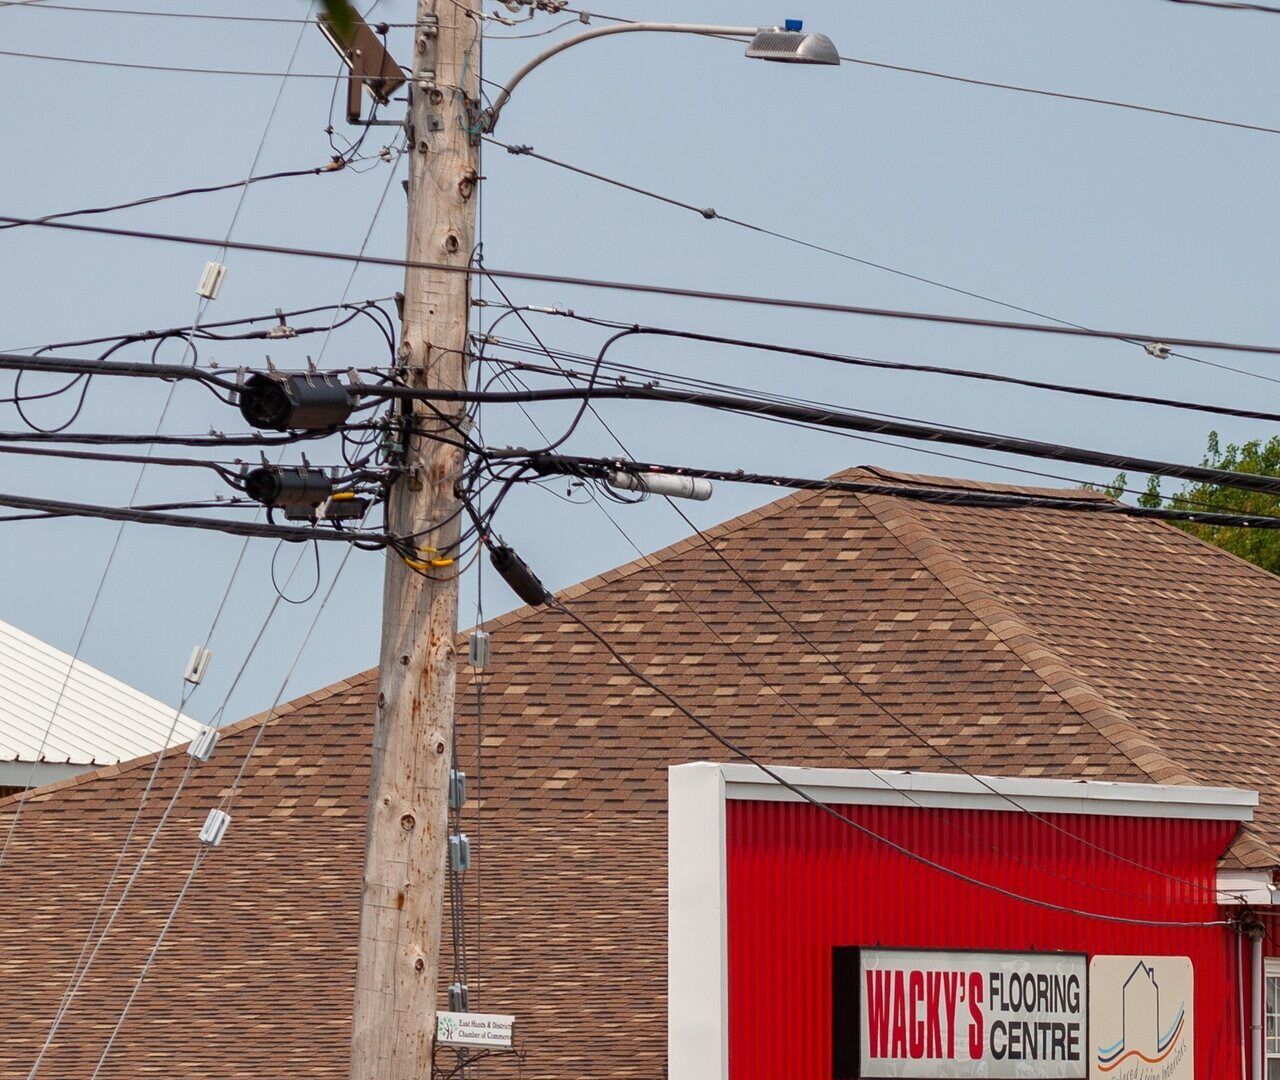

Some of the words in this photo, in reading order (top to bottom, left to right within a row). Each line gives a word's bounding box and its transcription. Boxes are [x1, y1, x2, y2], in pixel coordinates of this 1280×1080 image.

[989, 972, 1080, 1013] FLOORING
[458, 1030, 480, 1038] Chamber
[459, 1019, 471, 1027] East
[866, 970, 983, 1060] WACKY'S
[990, 1022, 1080, 1061] CENTRE
[1162, 1038, 1187, 1080] Interiors
